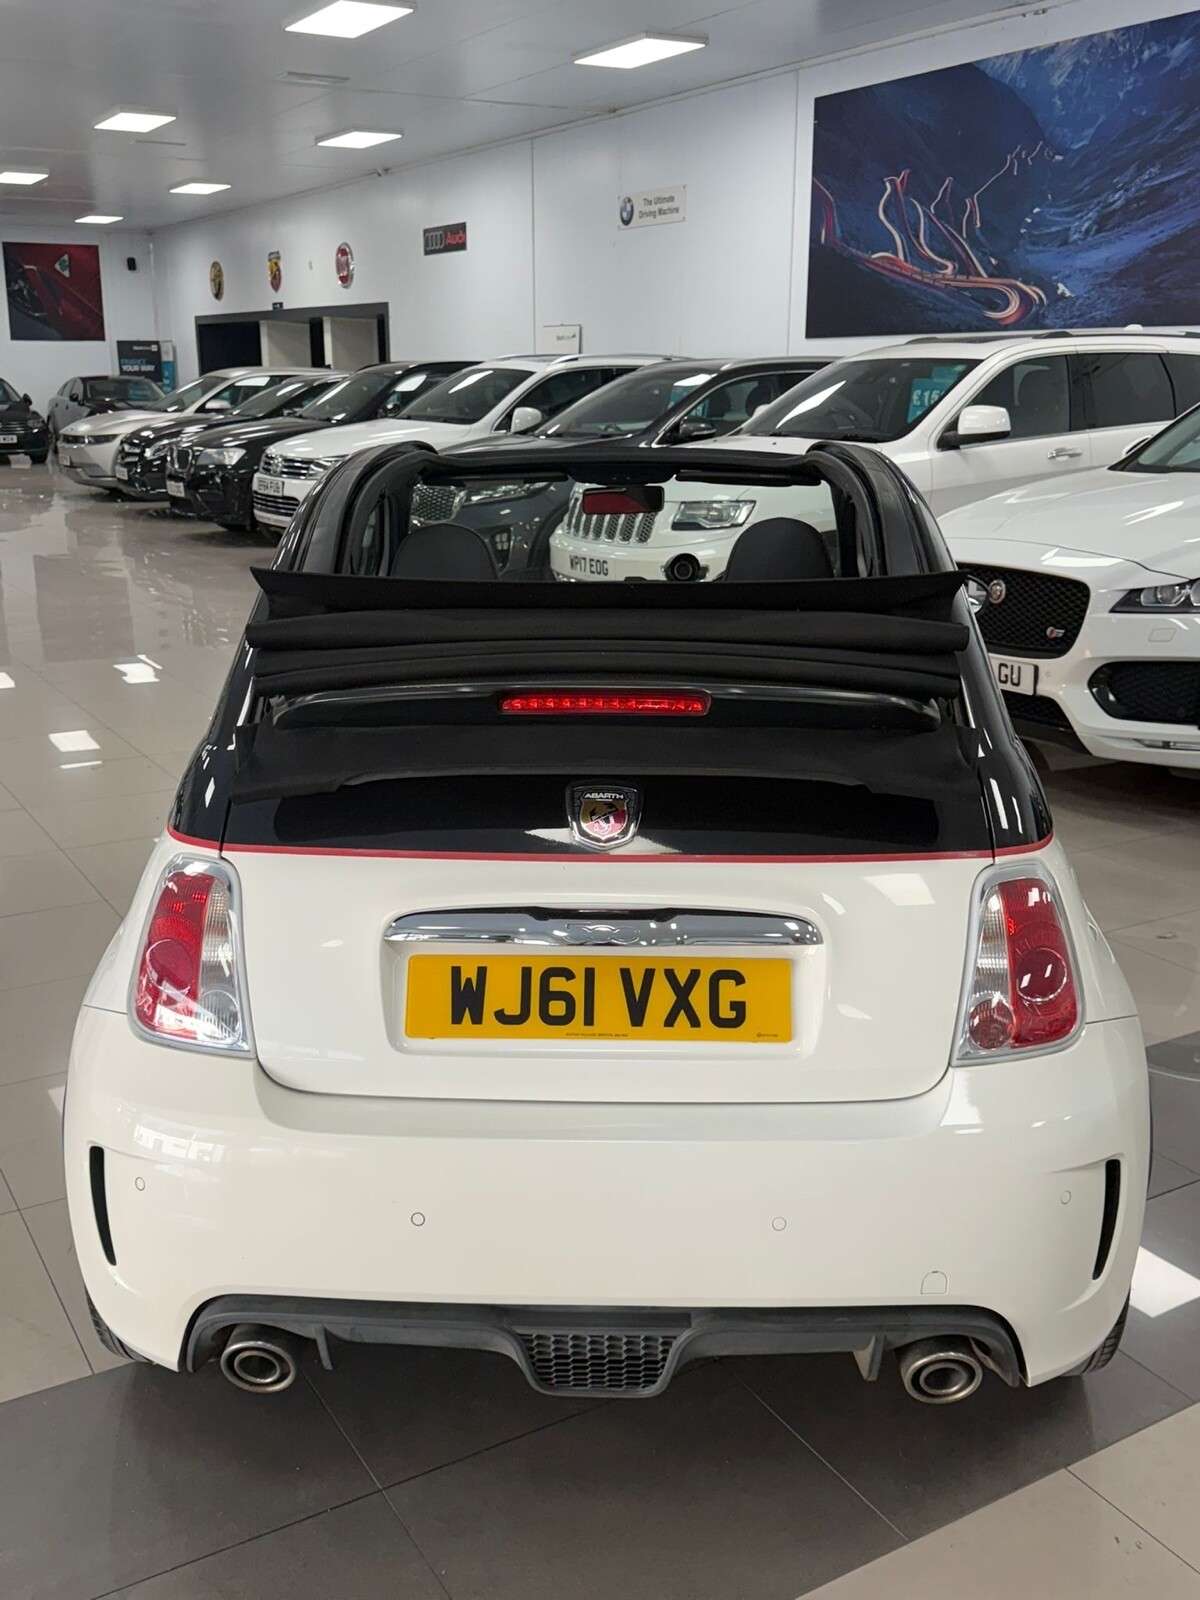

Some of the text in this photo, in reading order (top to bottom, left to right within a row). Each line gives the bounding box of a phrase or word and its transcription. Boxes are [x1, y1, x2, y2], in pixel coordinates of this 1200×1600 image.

[643, 195, 675, 206] The Ultimate
[638, 207, 680, 219] Driving Machine
[569, 554, 587, 573] WP17
[450, 965, 746, 1028] WJ61 VXG
